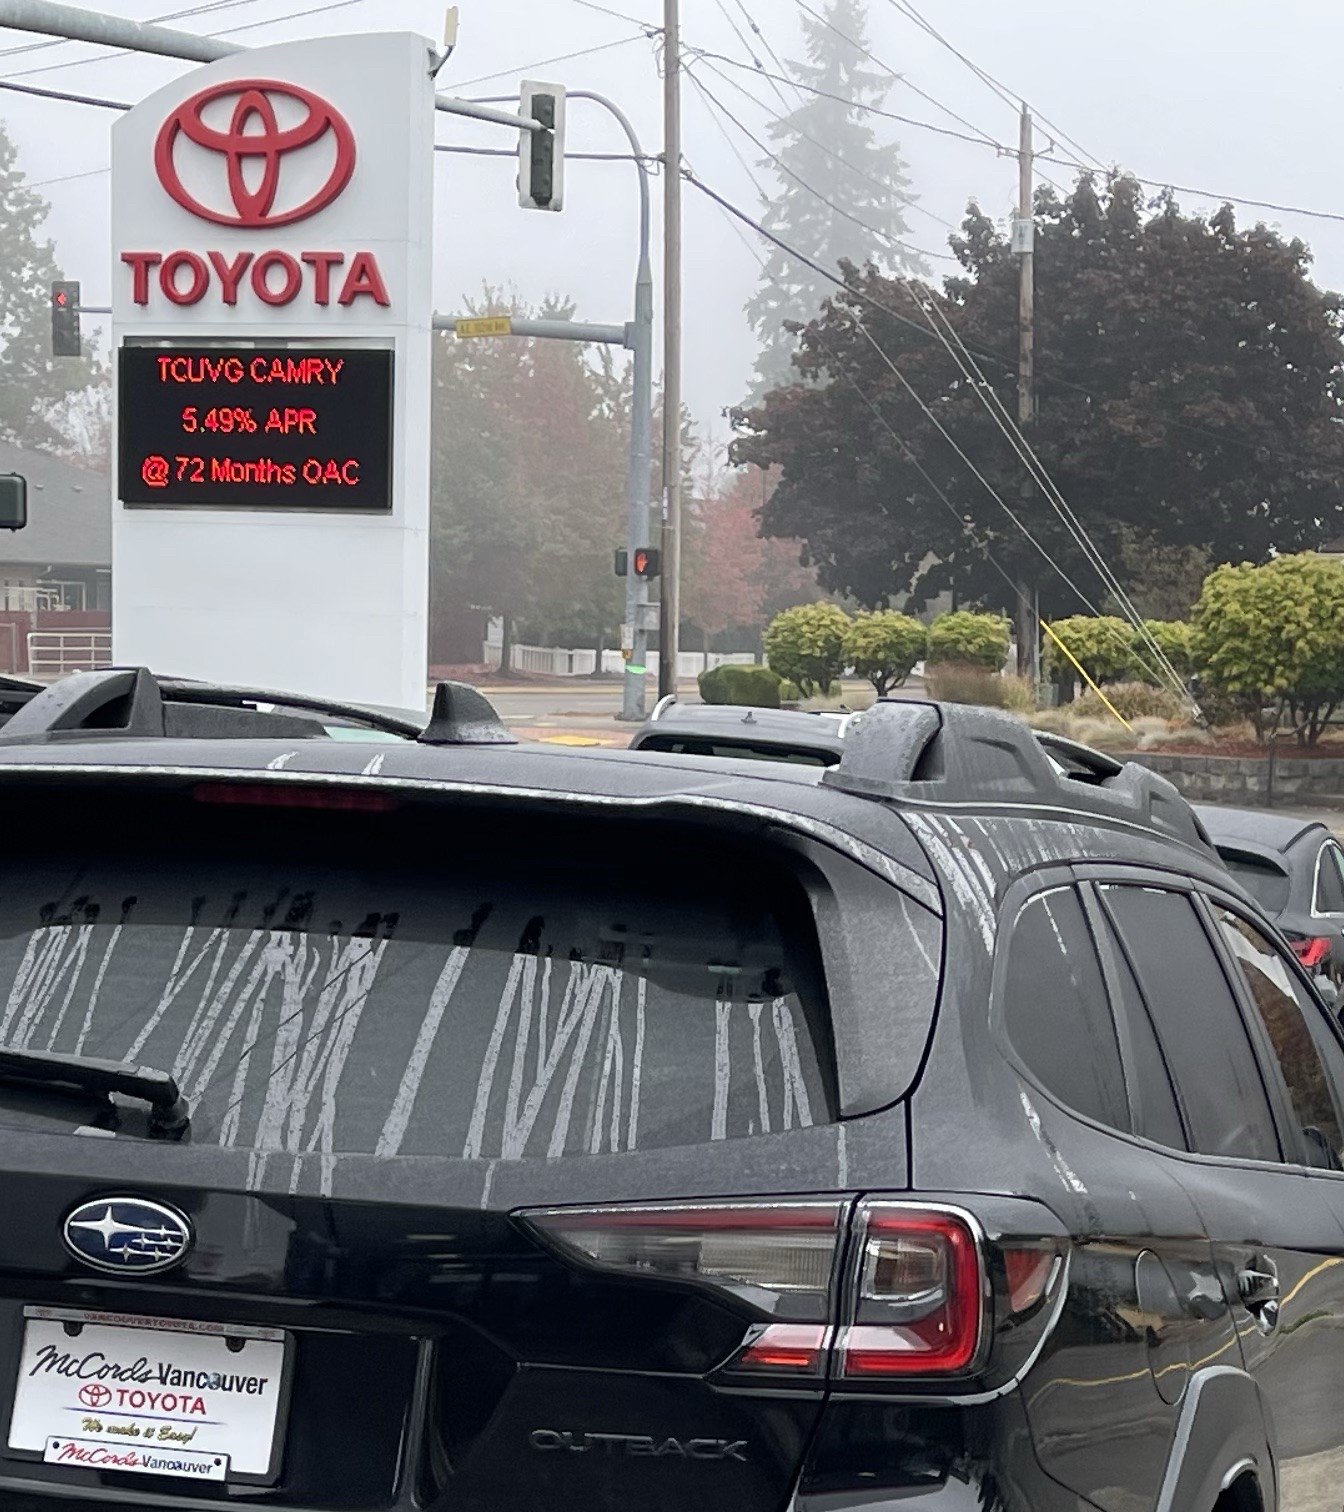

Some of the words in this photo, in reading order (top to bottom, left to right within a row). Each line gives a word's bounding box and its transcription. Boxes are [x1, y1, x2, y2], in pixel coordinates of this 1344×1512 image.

[121, 250, 391, 308] TOYOTA
[250, 357, 344, 385] CAMRY
[182, 407, 257, 433] 5.49%
[265, 407, 318, 435] APR
[142, 455, 170, 487] @
[176, 456, 205, 483] 72
[211, 457, 297, 484] Months
[303, 459, 360, 486] OAC
[116, 1388, 207, 1416] TOYOTA
[529, 1428, 749, 1463] OUTBACK
